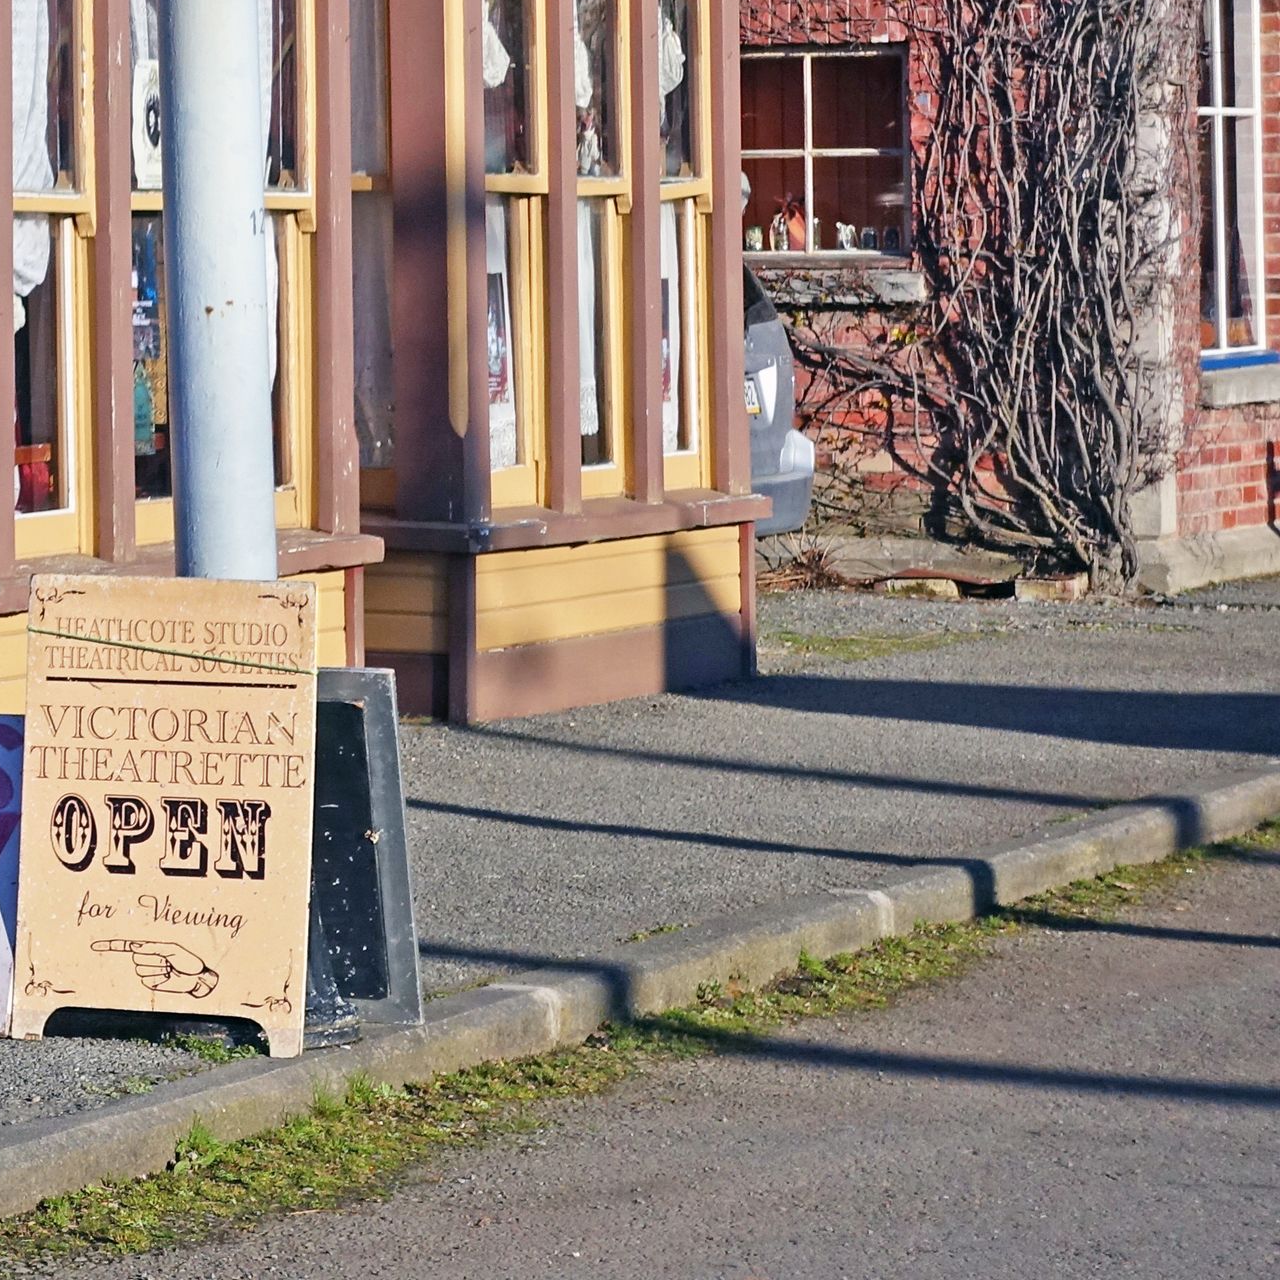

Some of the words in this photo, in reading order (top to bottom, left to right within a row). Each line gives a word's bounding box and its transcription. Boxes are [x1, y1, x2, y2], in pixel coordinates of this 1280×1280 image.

[55, 616, 195, 645] HEATHCOTE
[203, 621, 288, 647] STUDIO
[45, 646, 183, 673] THEATRICAL
[38, 704, 298, 746] VICTORIAN
[30, 745, 306, 789] THEATRETTE
[51, 793, 272, 880] OPEN
[77, 890, 117, 926] for
[138, 894, 248, 938] Viewing
